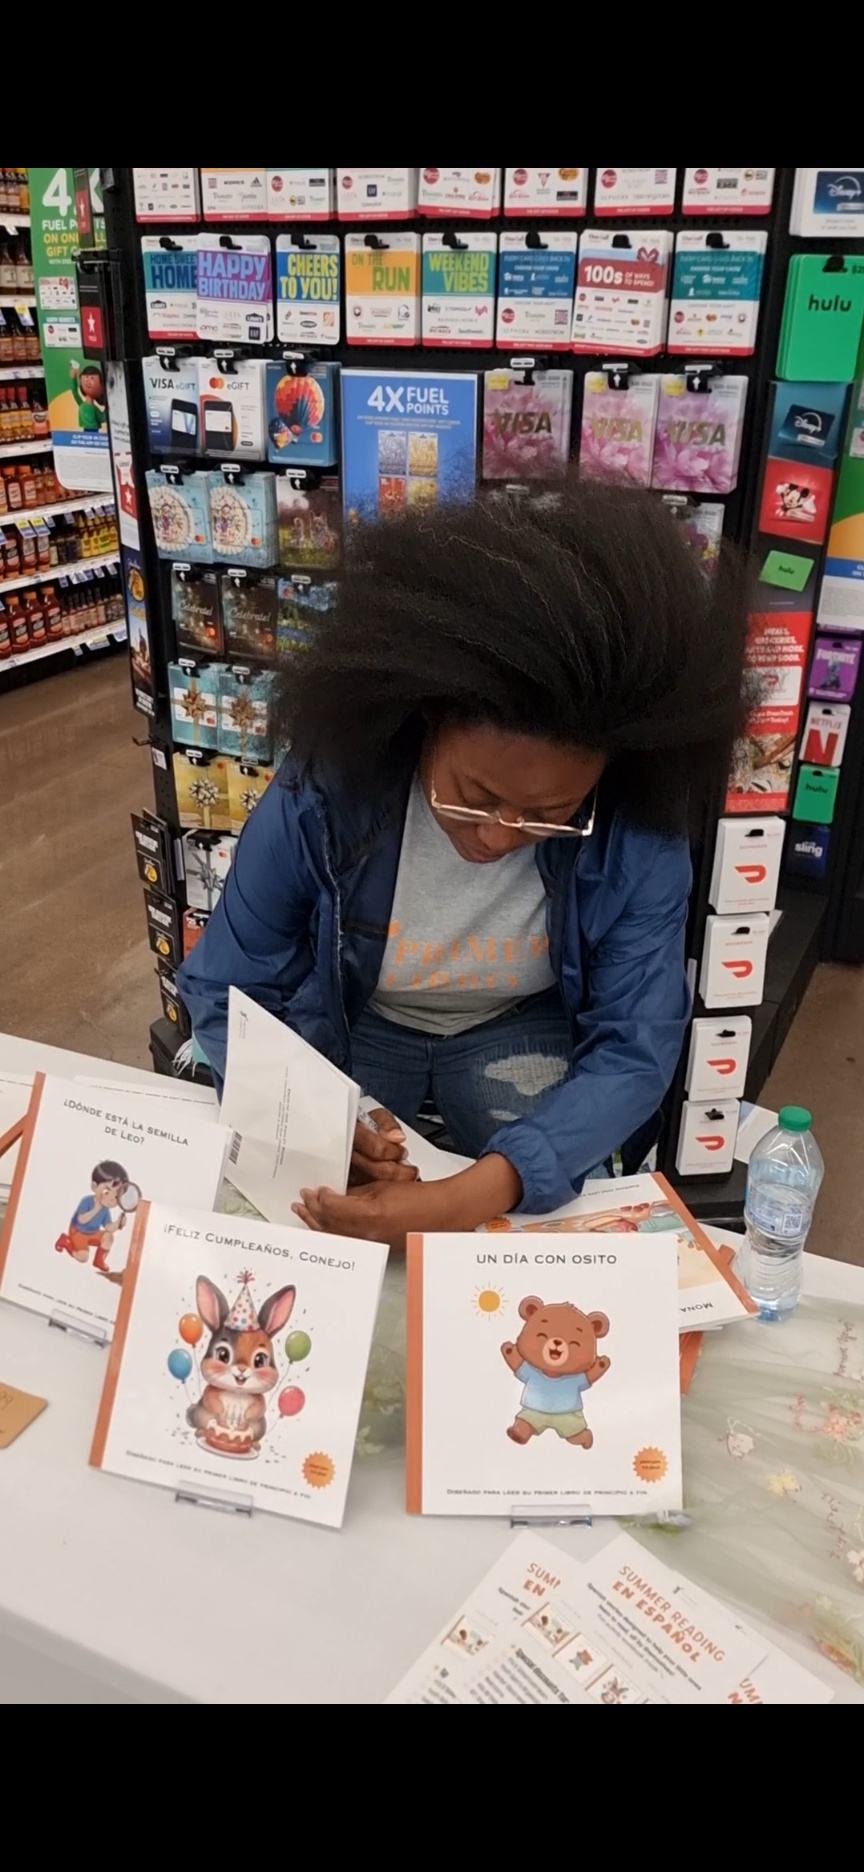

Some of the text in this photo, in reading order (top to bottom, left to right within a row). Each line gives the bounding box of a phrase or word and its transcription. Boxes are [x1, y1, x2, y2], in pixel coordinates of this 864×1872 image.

[42, 219, 67, 231] FUEL
[43, 233, 58, 244] ON
[46, 246, 68, 257] GIFT
[173, 254, 197, 265] SWEE
[352, 253, 364, 265] ON
[199, 251, 267, 280] HAPPY
[287, 254, 339, 277] CHEERS
[429, 253, 490, 272] WEEKEND
[372, 266, 410, 291] RUN
[443, 272, 489, 292] VIBES
[584, 264, 623, 285] 100s
[200, 278, 266, 300] BIRTHDAY
[280, 277, 338, 301] TO YOU!
[808, 294, 852, 312] hulu
[150, 378, 196, 391] VISA eGIFT
[227, 382, 250, 391] eGIFT
[367, 385, 449, 413] 4X FUEL
[406, 403, 449, 415] POINTS
[494, 411, 553, 435] VISA
[591, 413, 643, 443] VISA
[667, 417, 727, 446] VISA
[180, 601, 214, 617] Celebrate!
[230, 606, 272, 623] Celebrate!
[810, 717, 842, 730] NETFLIX
[805, 782, 829, 794] hulu
[794, 841, 823, 858] sling
[395, 936, 549, 965] PRIMER
[63, 1098, 189, 1146] ¿DÓNDE ESTÁ LA SEMILLA
[104, 1126, 145, 1146] DE LEO?
[164, 1224, 356, 1271] ¡FELIZ CUMPLEAÑOS, CONEJO!
[476, 1252, 617, 1265] UN DÍA CON OSITO
[523, 1579, 546, 1597] EN
[612, 1580, 701, 1663] EN ESPAÑOL
[619, 1565, 726, 1662] SUMMER READING
[740, 1678, 763, 1704] UM
